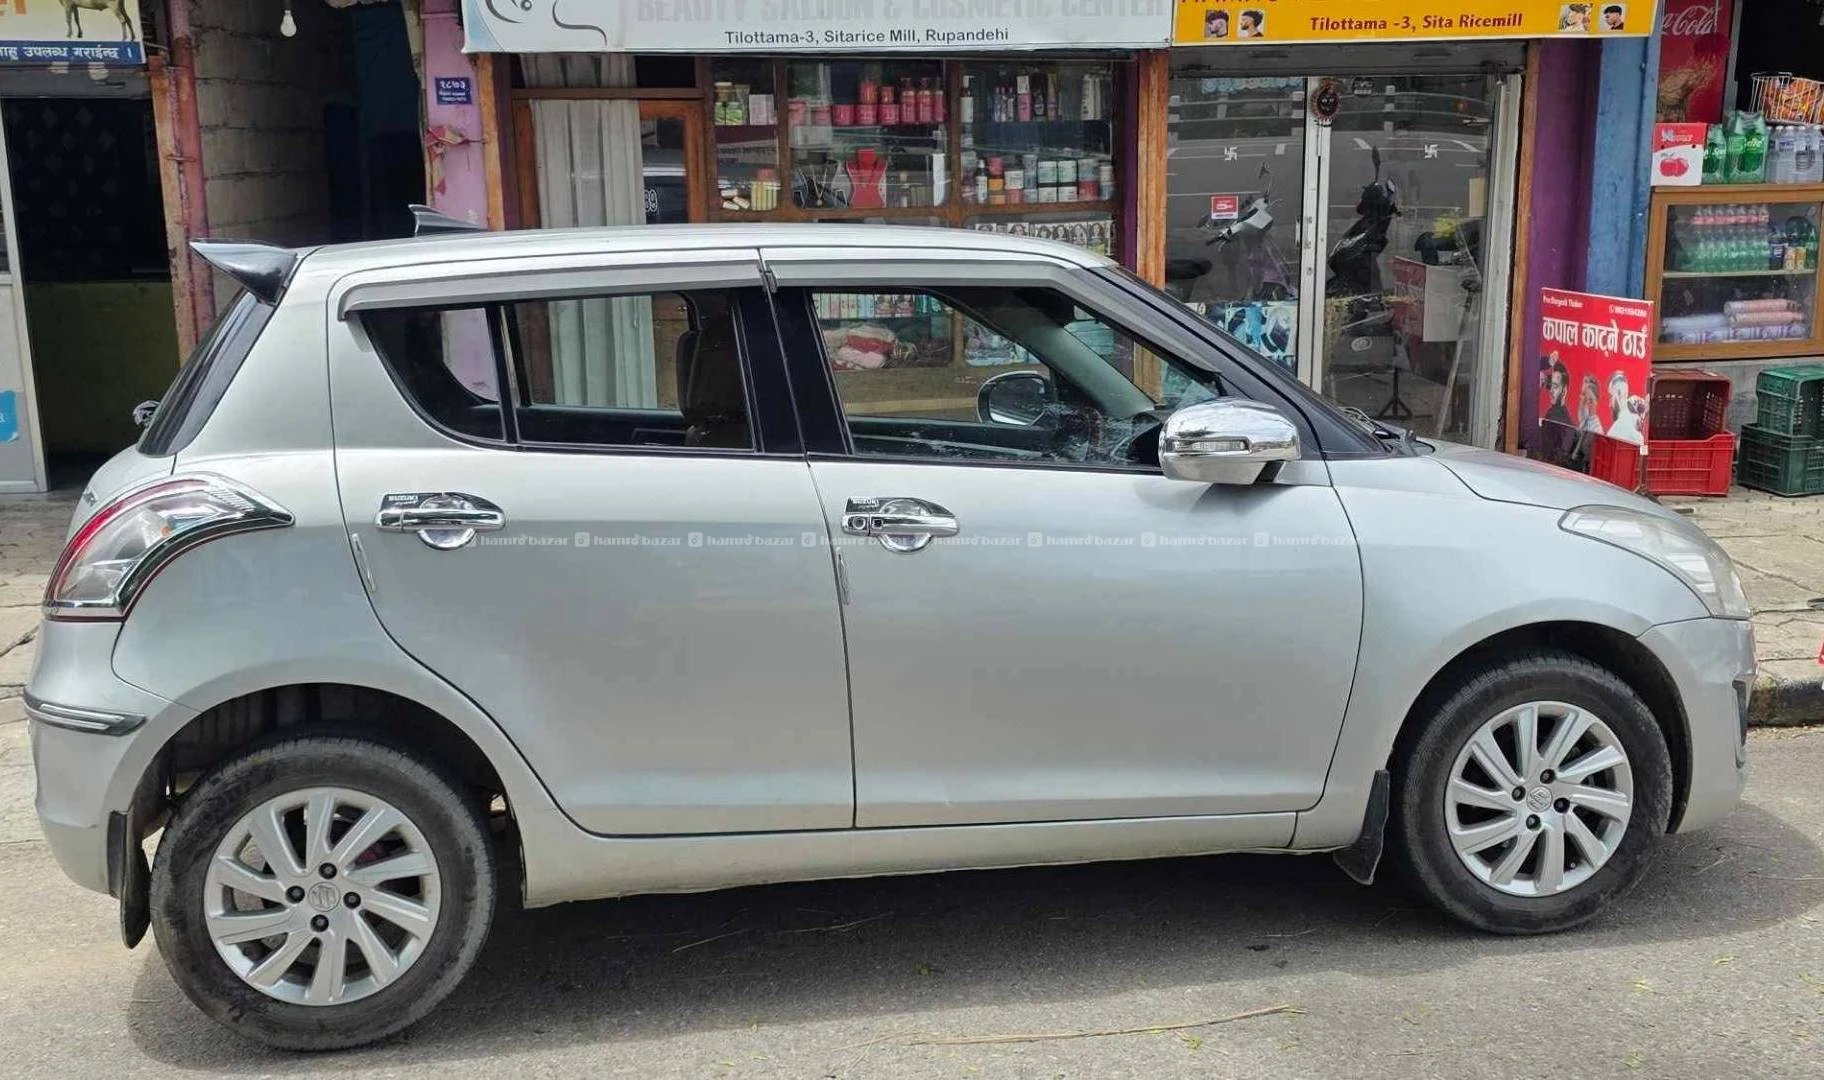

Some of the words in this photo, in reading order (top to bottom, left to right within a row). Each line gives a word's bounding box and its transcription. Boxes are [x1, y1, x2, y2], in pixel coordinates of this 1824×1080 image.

[1310, 16, 1387, 31] Tilottama
[1422, 15, 1453, 29] Sita
[1459, 13, 1523, 29] Ricemill
[724, 30, 819, 45] Tilottama-3,
[824, 29, 886, 44] Sitarice
[889, 28, 921, 44] Mill,
[926, 27, 1009, 45] Rupandehi
[1542, 316, 1579, 347] कपाल
[1582, 318, 1619, 358] काट्ने
[1622, 323, 1649, 360] ठाउँ
